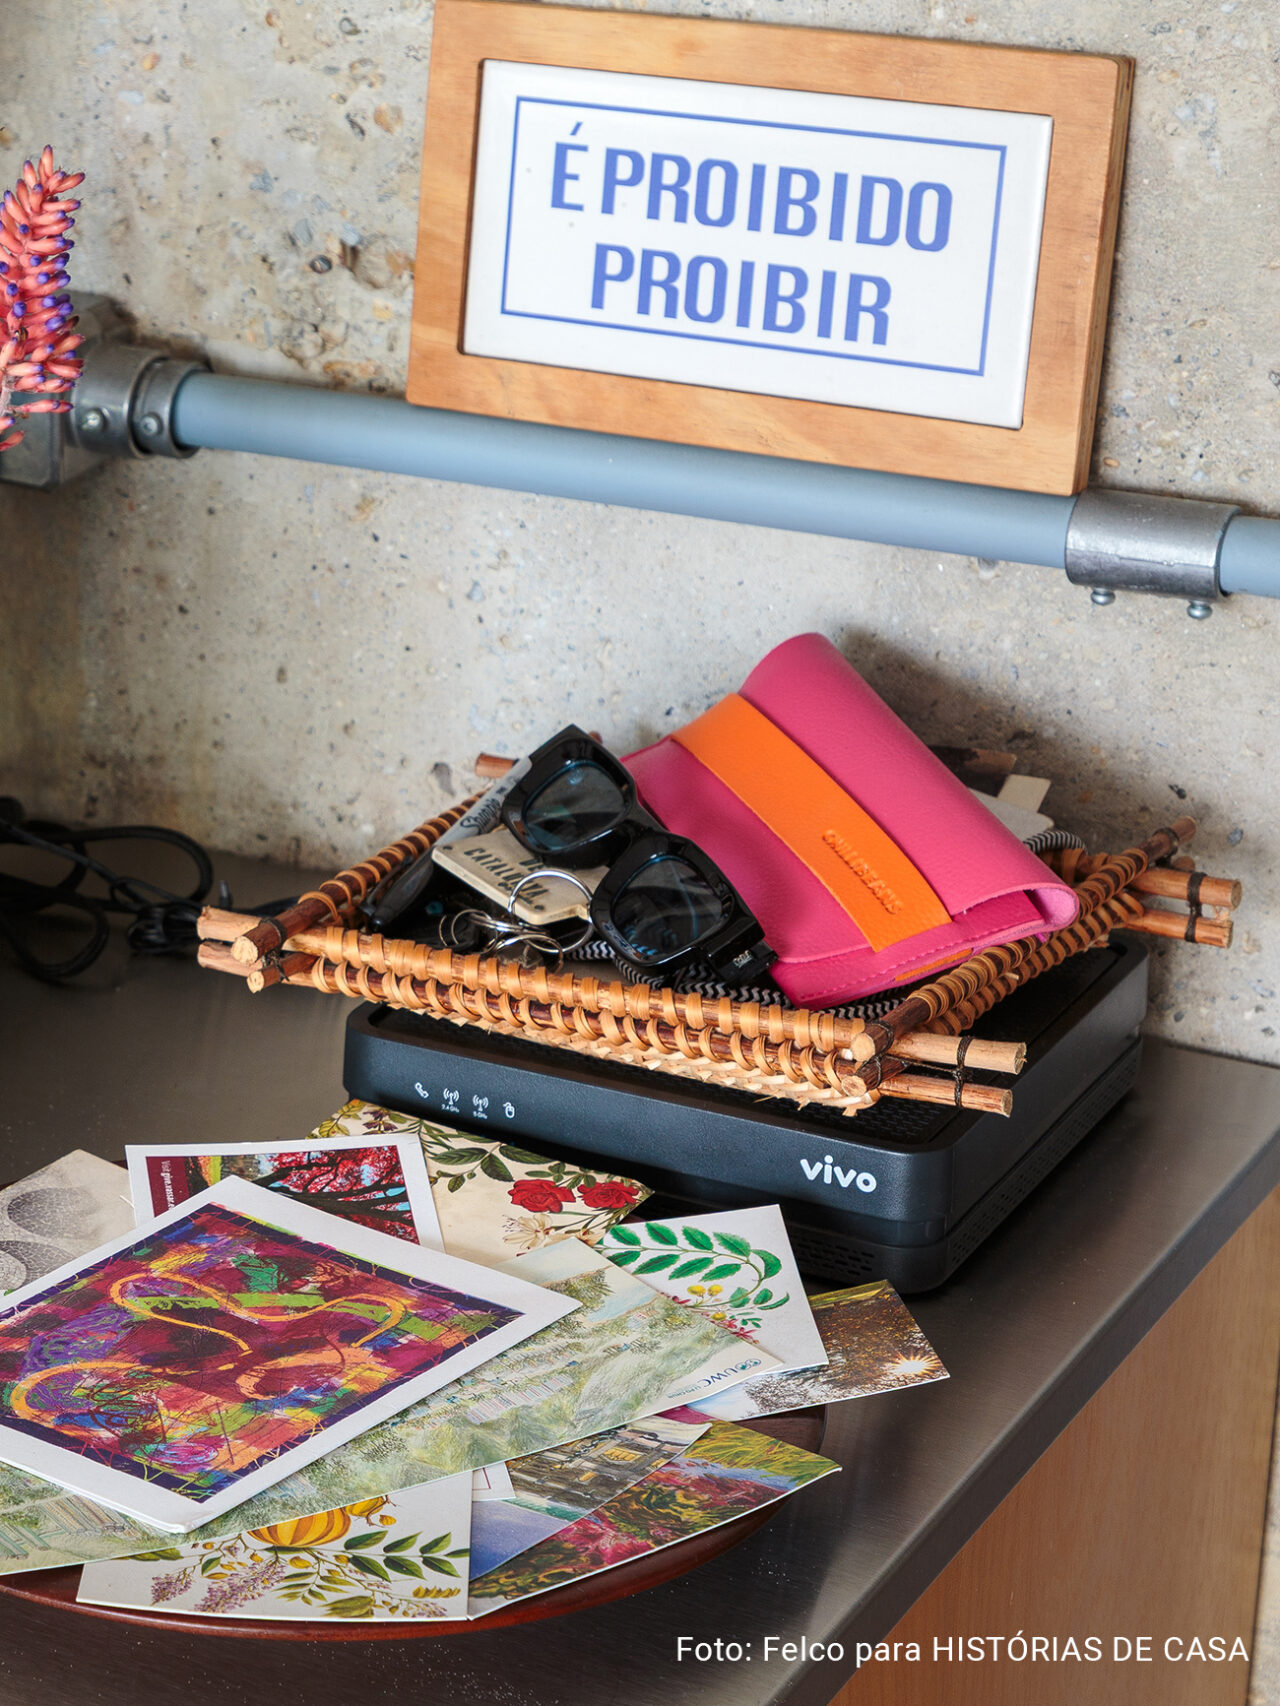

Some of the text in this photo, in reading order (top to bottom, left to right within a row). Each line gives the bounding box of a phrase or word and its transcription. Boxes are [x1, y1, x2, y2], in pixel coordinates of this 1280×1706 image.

[550, 121, 953, 253] É PROIBIDO
[590, 242, 892, 346] PROIBIR
[800, 1154, 877, 1193] vivo
[697, 1367, 739, 1388] UWC
